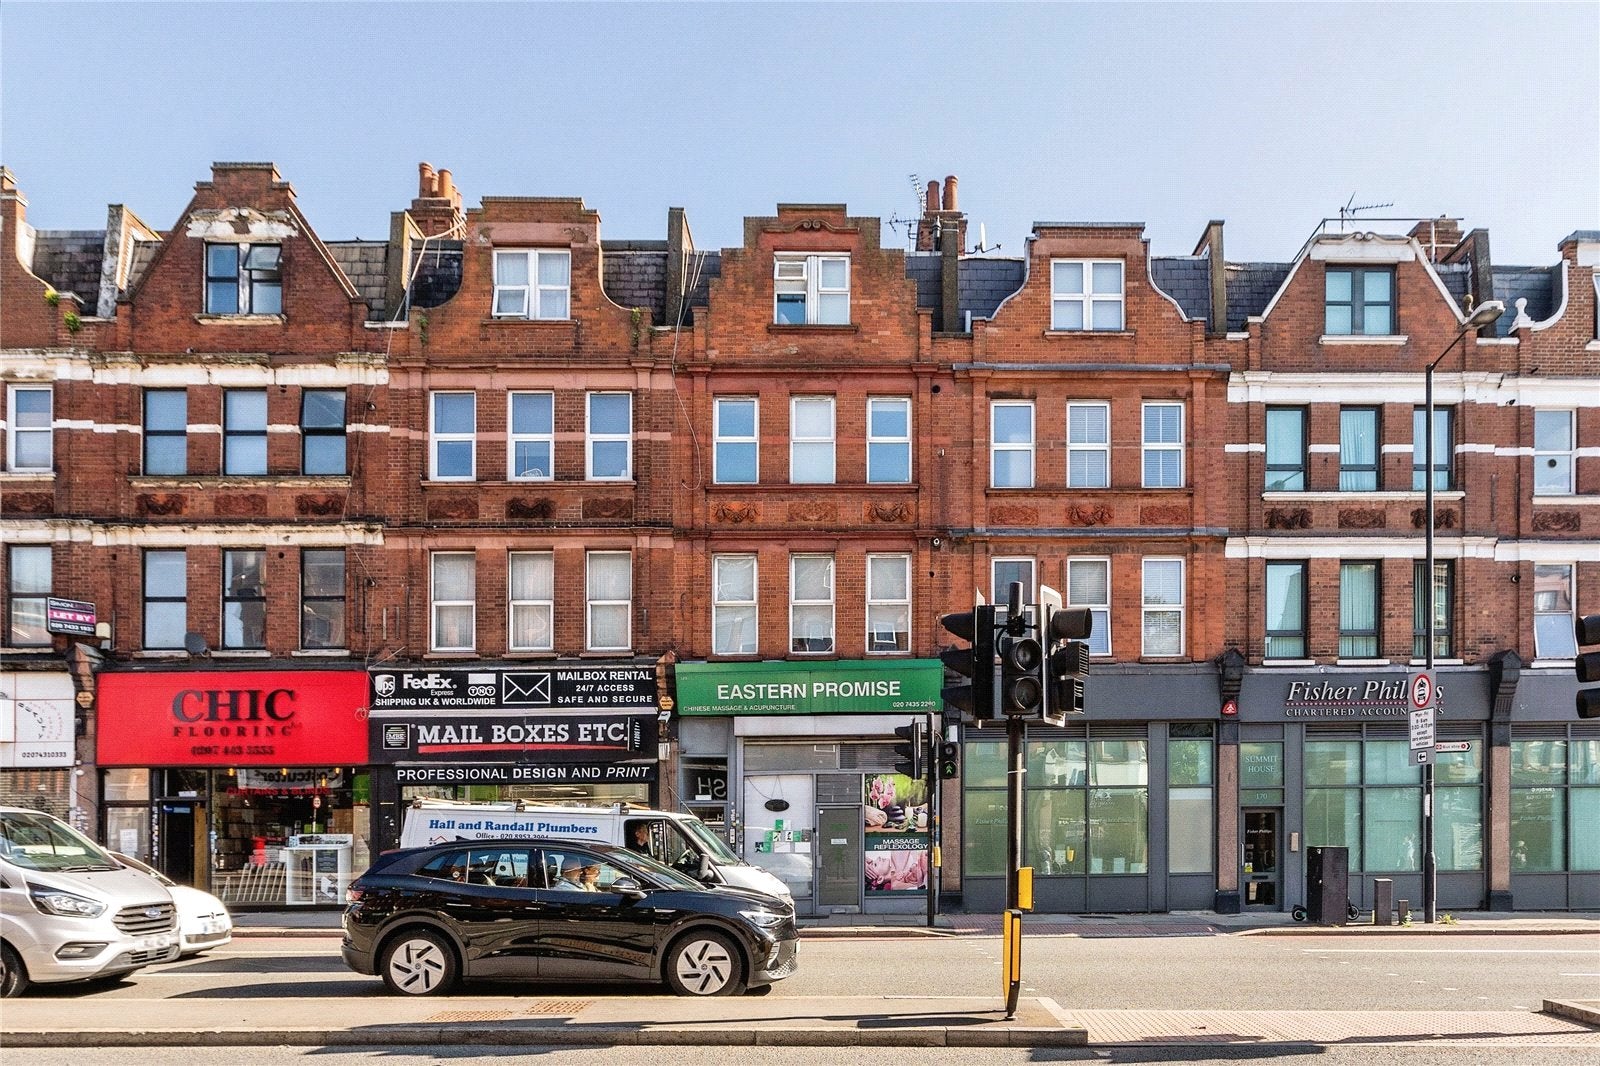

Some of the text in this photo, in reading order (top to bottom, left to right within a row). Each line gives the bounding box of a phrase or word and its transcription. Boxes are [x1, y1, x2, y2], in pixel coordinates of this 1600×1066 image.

[53, 612, 74, 620] LET
[403, 674, 452, 689] FedEx
[557, 671, 652, 682] MAILBOX RENTAL
[431, 690, 454, 698] Express
[468, 686, 496, 696] TNT
[717, 681, 901, 700] EASTERN PROMISE
[1287, 680, 1444, 701] Fisher Phils
[172, 688, 296, 722] CHIC
[441, 697, 496, 706] WORLDWIDE
[1286, 708, 1354, 716] CHARTERED
[173, 726, 292, 737] FLOORING
[418, 725, 484, 744] MAIL
[492, 724, 570, 744] BOXES
[398, 766, 650, 781] PROFESSIONAL DESIGN AND PRINT
[429, 820, 598, 834] Hall and Randall Plumbers
